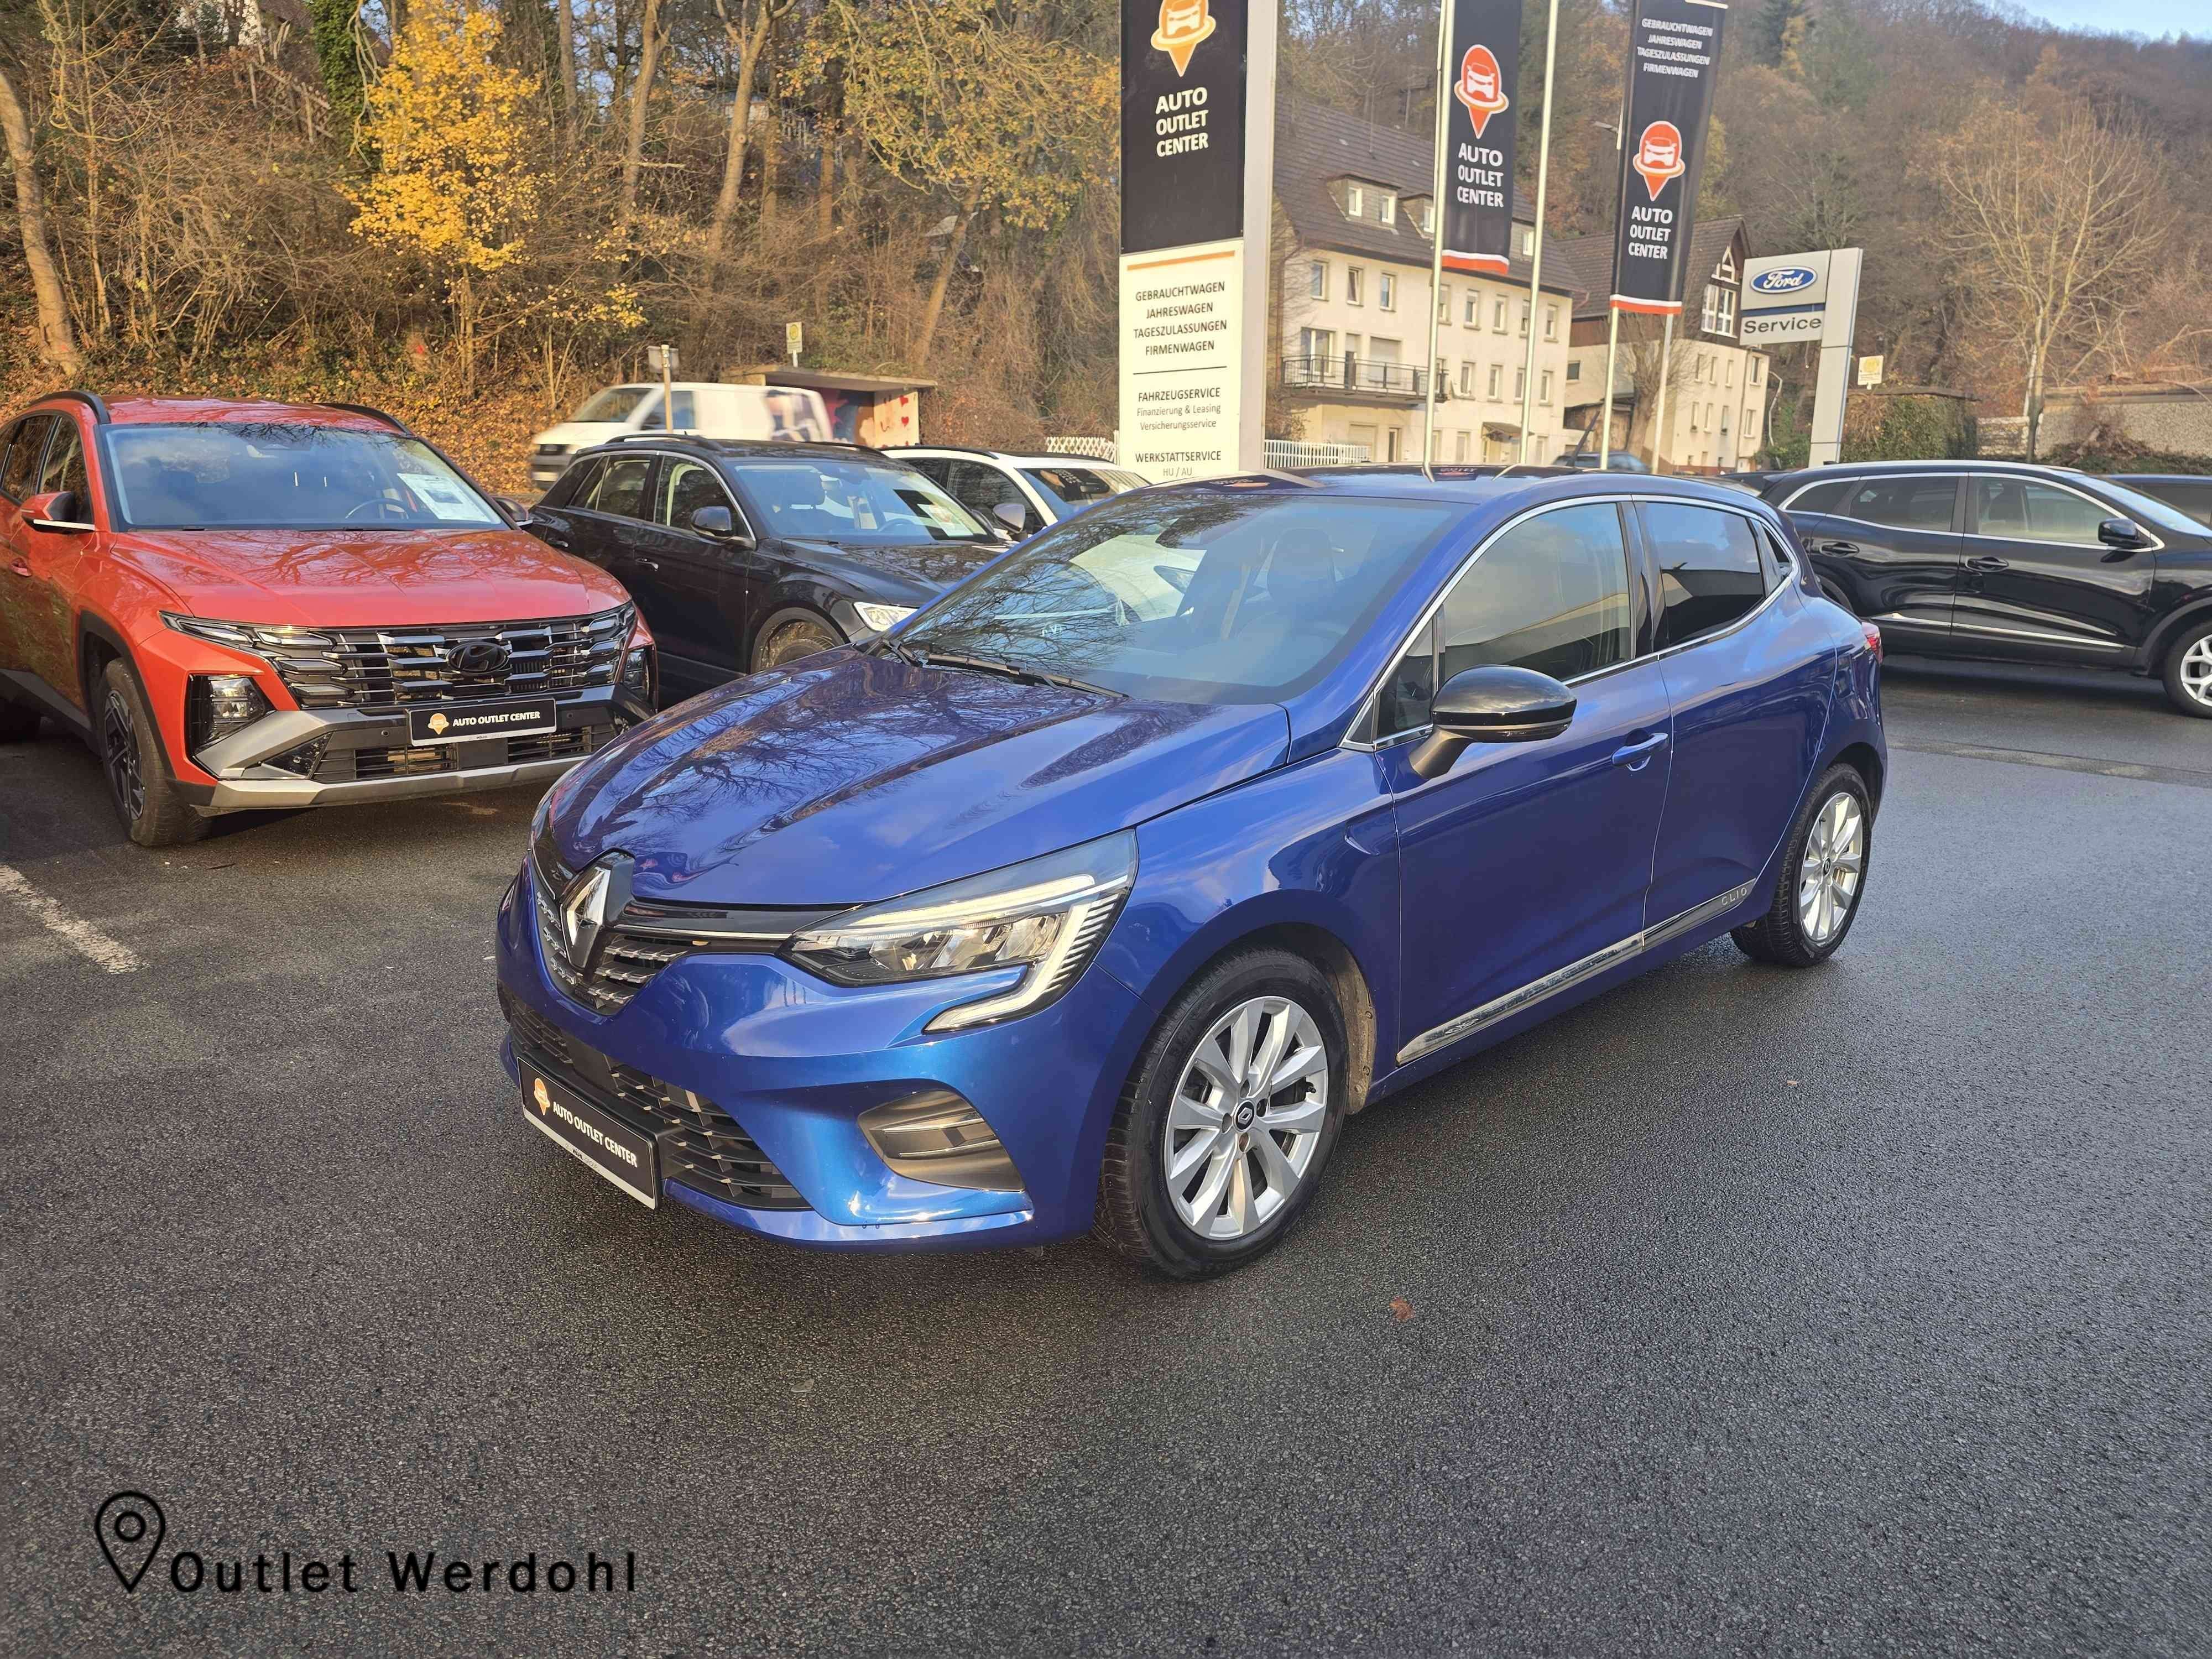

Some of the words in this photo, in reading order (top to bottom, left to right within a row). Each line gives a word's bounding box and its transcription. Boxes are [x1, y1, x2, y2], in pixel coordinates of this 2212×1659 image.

[1641, 18, 1713, 36] GEBRAUCHTWAGEN
[1648, 34, 1702, 49] JAHRESWAGEN
[1637, 46, 1710, 65] TAGESZULASSUNGEN
[1644, 62, 1699, 78] FIRMENWAGEN
[1155, 87, 1208, 114] AUTO
[1156, 109, 1208, 135] OUTLET
[1156, 132, 1209, 157] CENTER
[1458, 143, 1503, 166] AUTO
[1458, 165, 1504, 187] OUTLET
[1457, 187, 1504, 208] CENTER
[1631, 206, 1673, 224] AUTO
[1630, 224, 1671, 241] OUTLET
[1628, 242, 1668, 259] CENTER
[1763, 270, 1804, 289] Ford
[1135, 281, 1225, 301] GEBRAUCHTWAGEN
[1146, 302, 1213, 319] JAHRESWAGEN
[1134, 320, 1227, 339] TAGESZULASSUNGEN
[1744, 317, 1822, 333] Service
[1145, 340, 1214, 356] FIRMENWAGEN
[1138, 387, 1220, 402] FAHRZEUGSERVICE
[1137, 407, 1182, 416] Finanzierung
[1185, 405, 1191, 414] &
[1193, 404, 1221, 415] Leasing
[1140, 419, 1217, 431] Versicherungsservice
[1135, 451, 1222, 463] WERKSTATTSERVICE
[1164, 468, 1173, 476] HU
[1176, 468, 1180, 477] /
[1182, 467, 1192, 476] AU
[452, 717, 477, 727] AUTO
[478, 714, 509, 724] OUTLET
[510, 711, 540, 722] CENTER
[1721, 888, 1747, 905] CLIO
[553, 1102, 573, 1124] AUTO
[574, 1117, 603, 1145] OUTLET
[604, 1137, 637, 1167] CENTER
